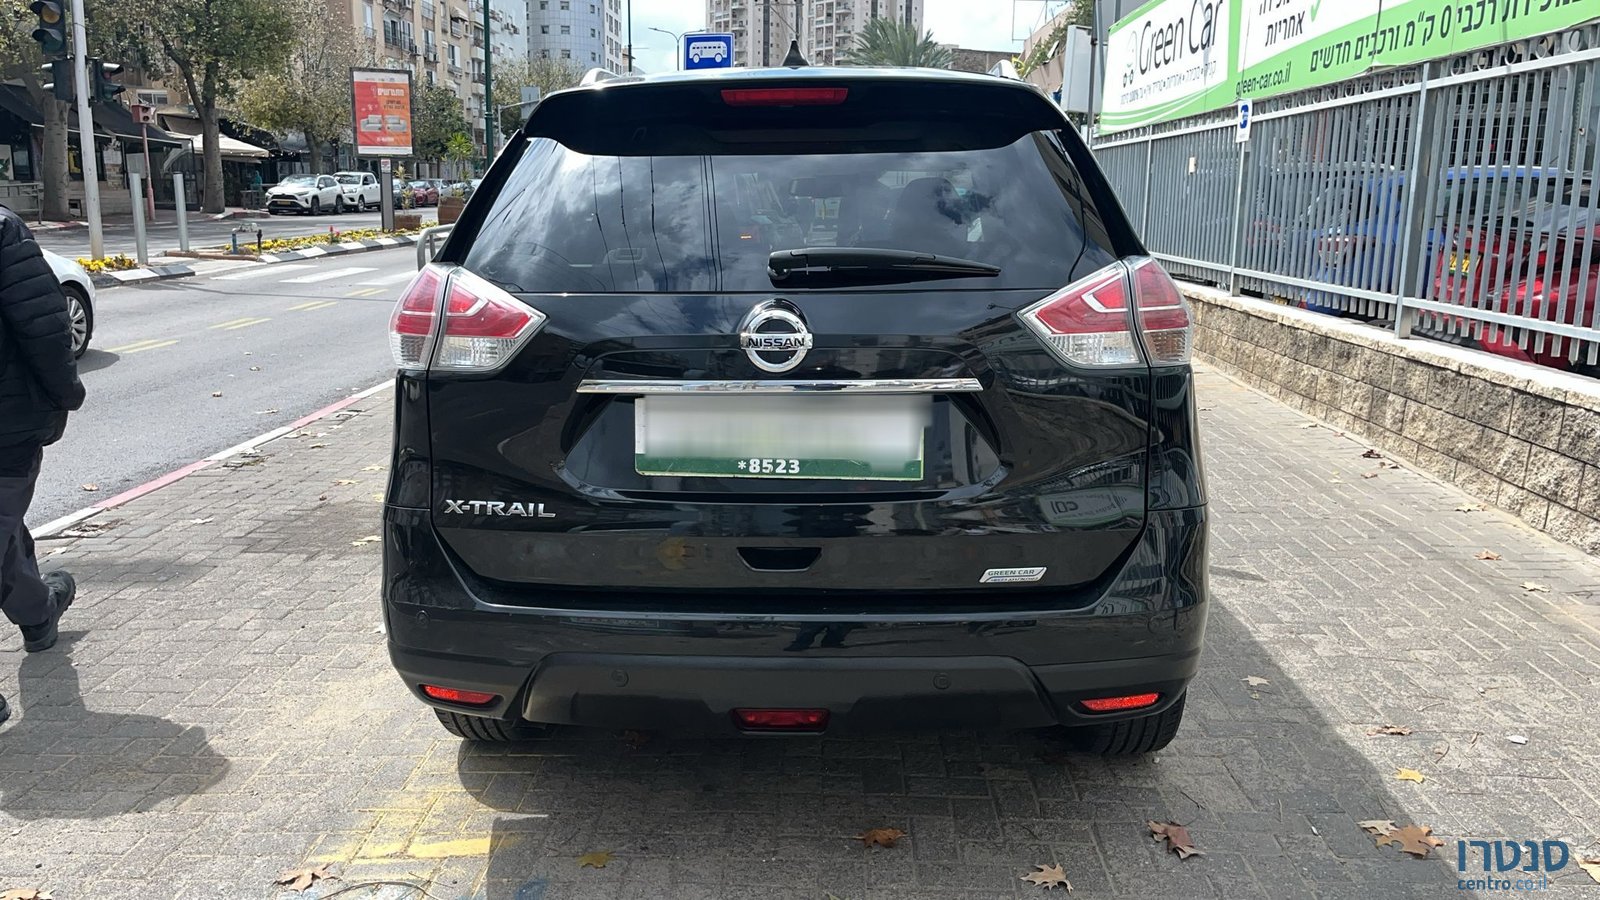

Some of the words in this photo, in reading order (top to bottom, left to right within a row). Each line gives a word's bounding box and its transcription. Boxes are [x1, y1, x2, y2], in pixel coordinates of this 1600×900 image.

[1265, 10, 1306, 47] אחריות
[1440, 5, 1452, 38] 0
[1457, 0, 1497, 33] רכבי
[1139, 17, 1184, 75] Green
[1188, 0, 1223, 54] Car
[1354, 25, 1401, 61] ורכבים
[1310, 40, 1352, 73] חדשים
[1235, 61, 1292, 98] green-car.co.il
[748, 338, 805, 348] NISSAN
[444, 499, 556, 518] X-TRAIL
